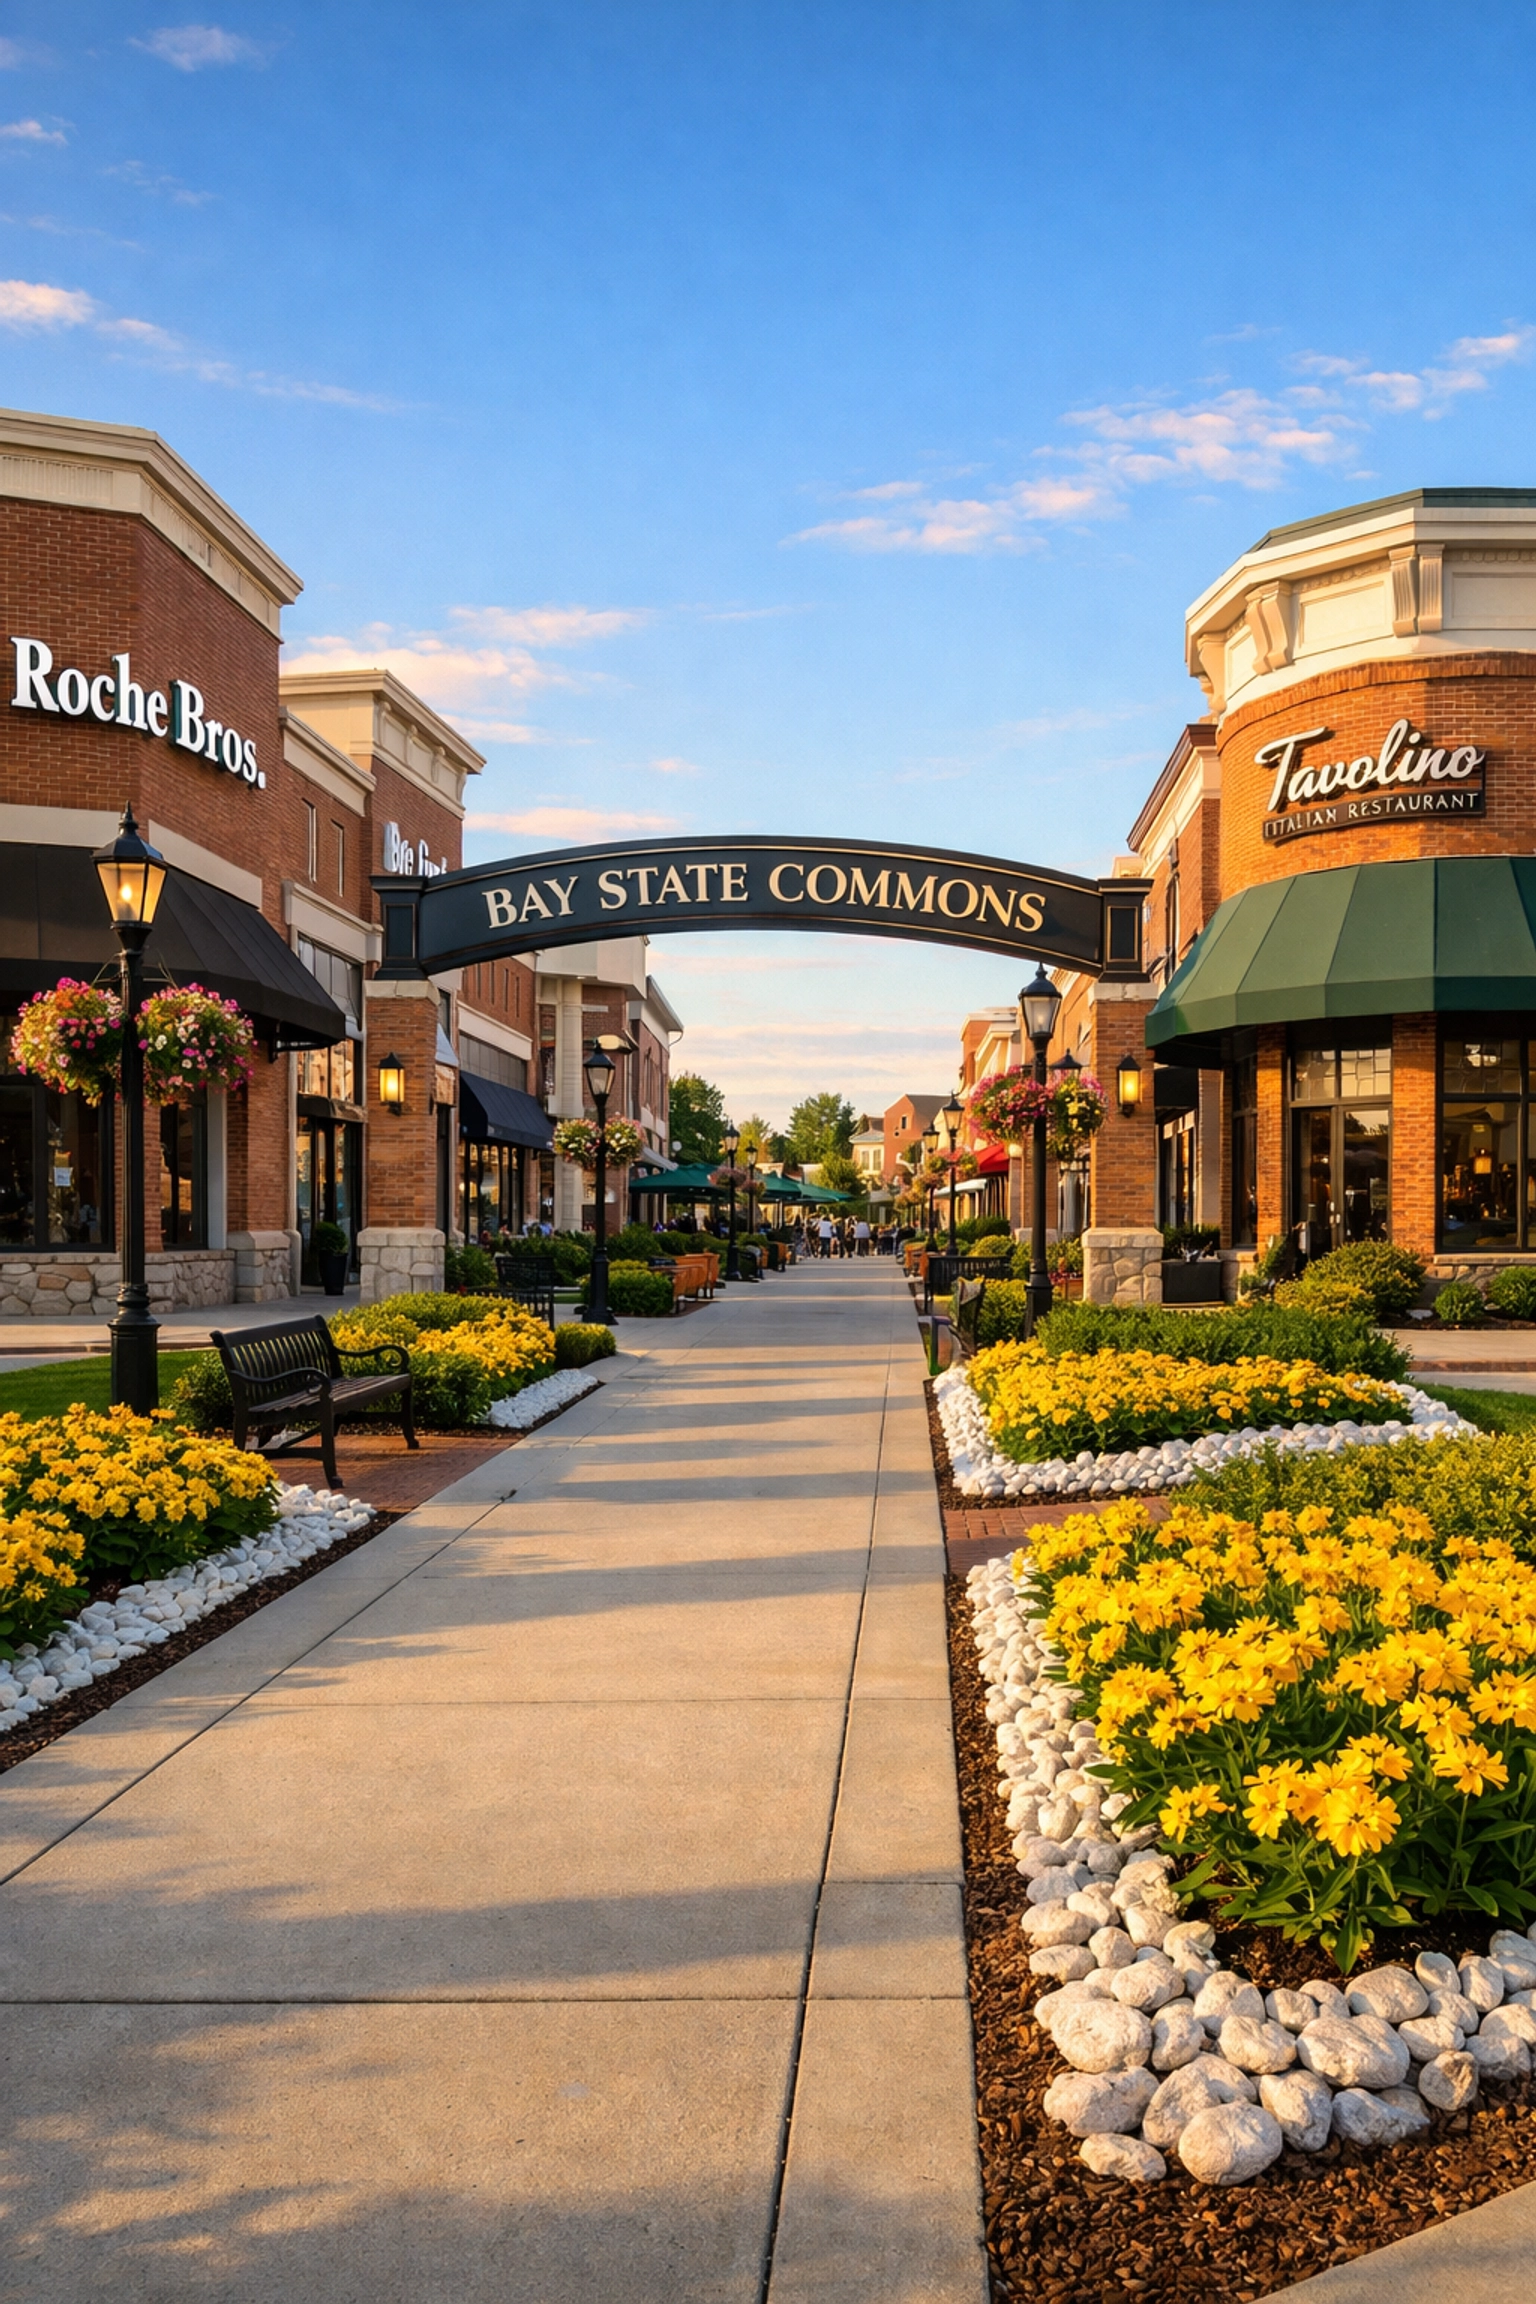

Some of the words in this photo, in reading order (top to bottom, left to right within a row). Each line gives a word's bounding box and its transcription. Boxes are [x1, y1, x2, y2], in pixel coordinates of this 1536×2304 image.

[10, 636, 168, 737] Roche
[175, 679, 266, 790] Bros.
[1254, 718, 1485, 812] Tavolino
[1348, 793, 1479, 818] RESTAURANT
[482, 876, 578, 929] BAY
[598, 863, 749, 910] STATE
[768, 863, 1047, 933] COMMONS
